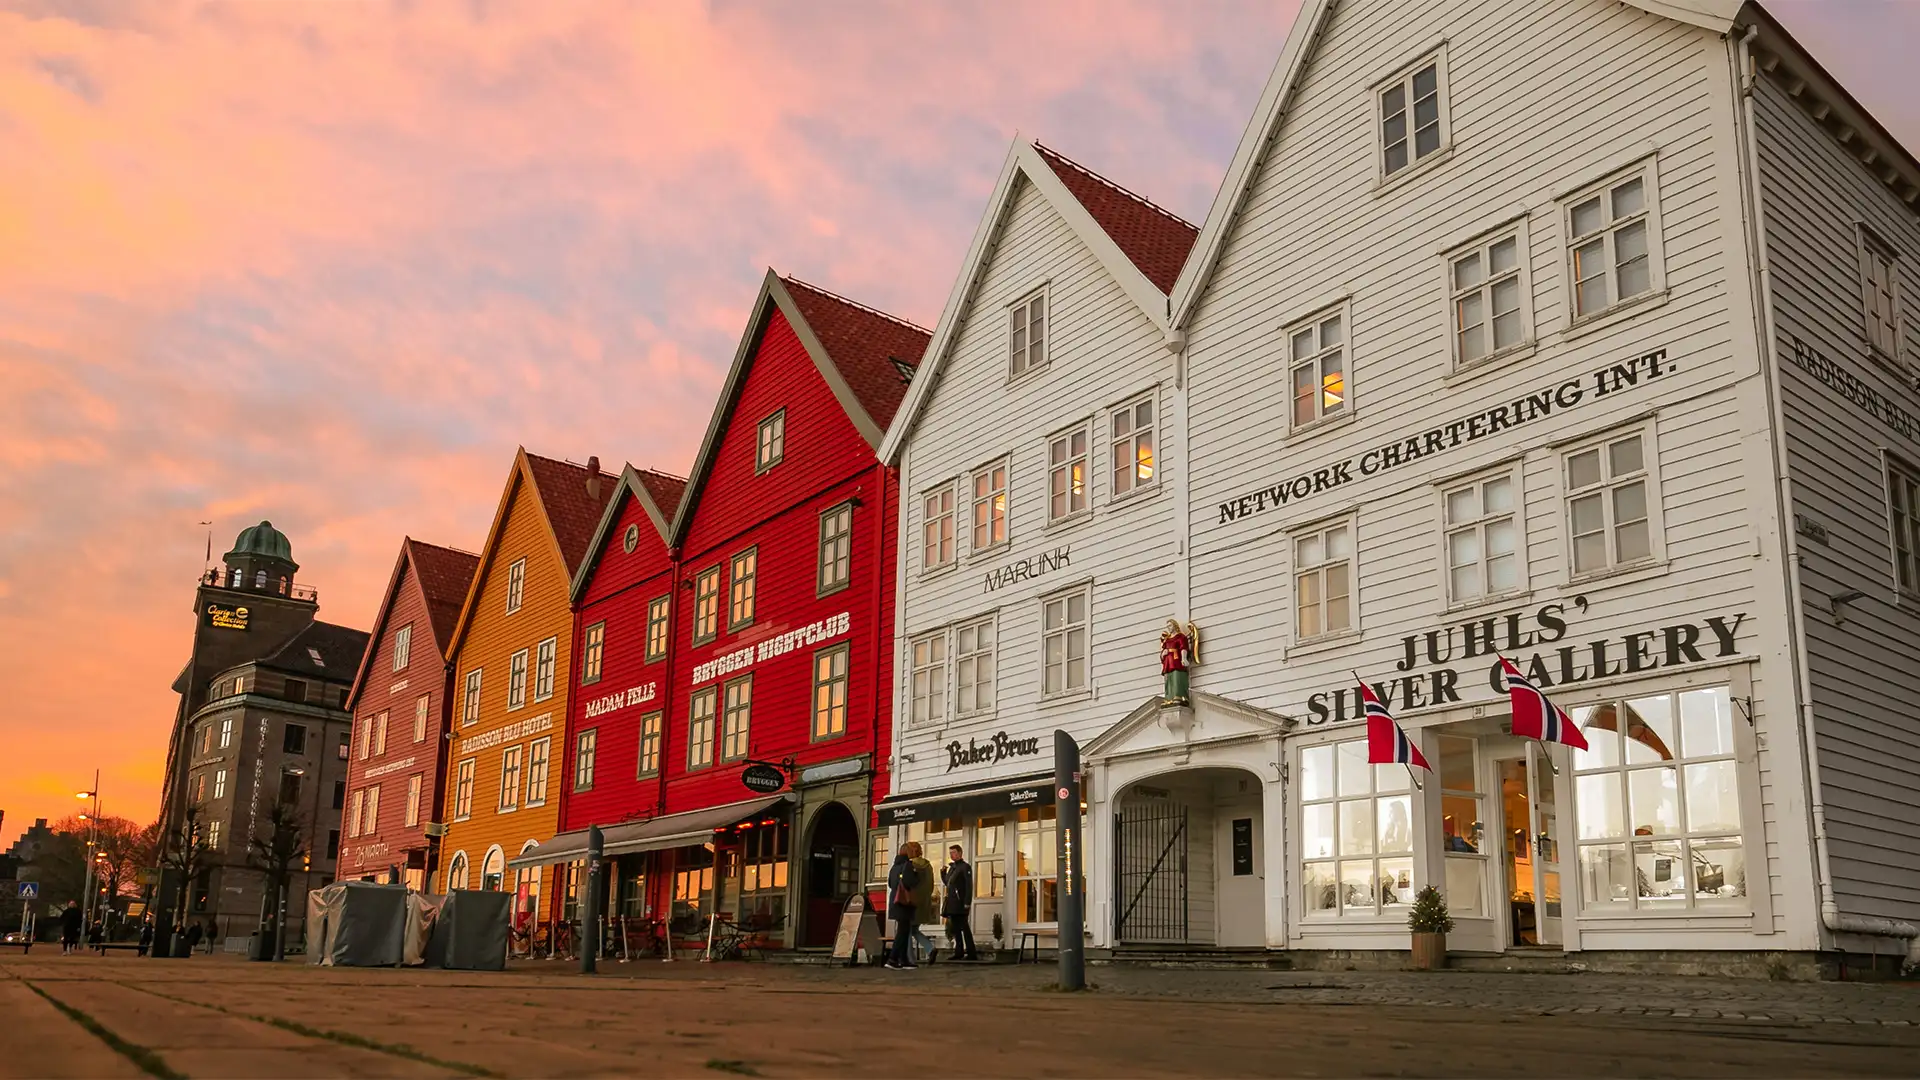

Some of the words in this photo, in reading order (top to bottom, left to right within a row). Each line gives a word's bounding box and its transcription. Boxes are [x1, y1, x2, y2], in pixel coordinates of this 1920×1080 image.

[1793, 336, 1879, 417] RADISSON
[1883, 397, 1912, 439] BLU
[1218, 460, 1354, 525] NETWORK
[1359, 379, 1585, 476] CHARTERING
[1593, 348, 1677, 399] INT.
[983, 544, 1071, 594] MARLINK
[692, 646, 755, 686] BRYGGEN
[757, 611, 850, 663] NIGHTCLUB
[585, 691, 626, 720] MADAM
[626, 681, 657, 707] FELLE
[461, 728, 503, 755] RADISSON
[503, 722, 522, 743] BLU
[522, 711, 553, 737] HOTEL
[945, 736, 994, 774] Baker
